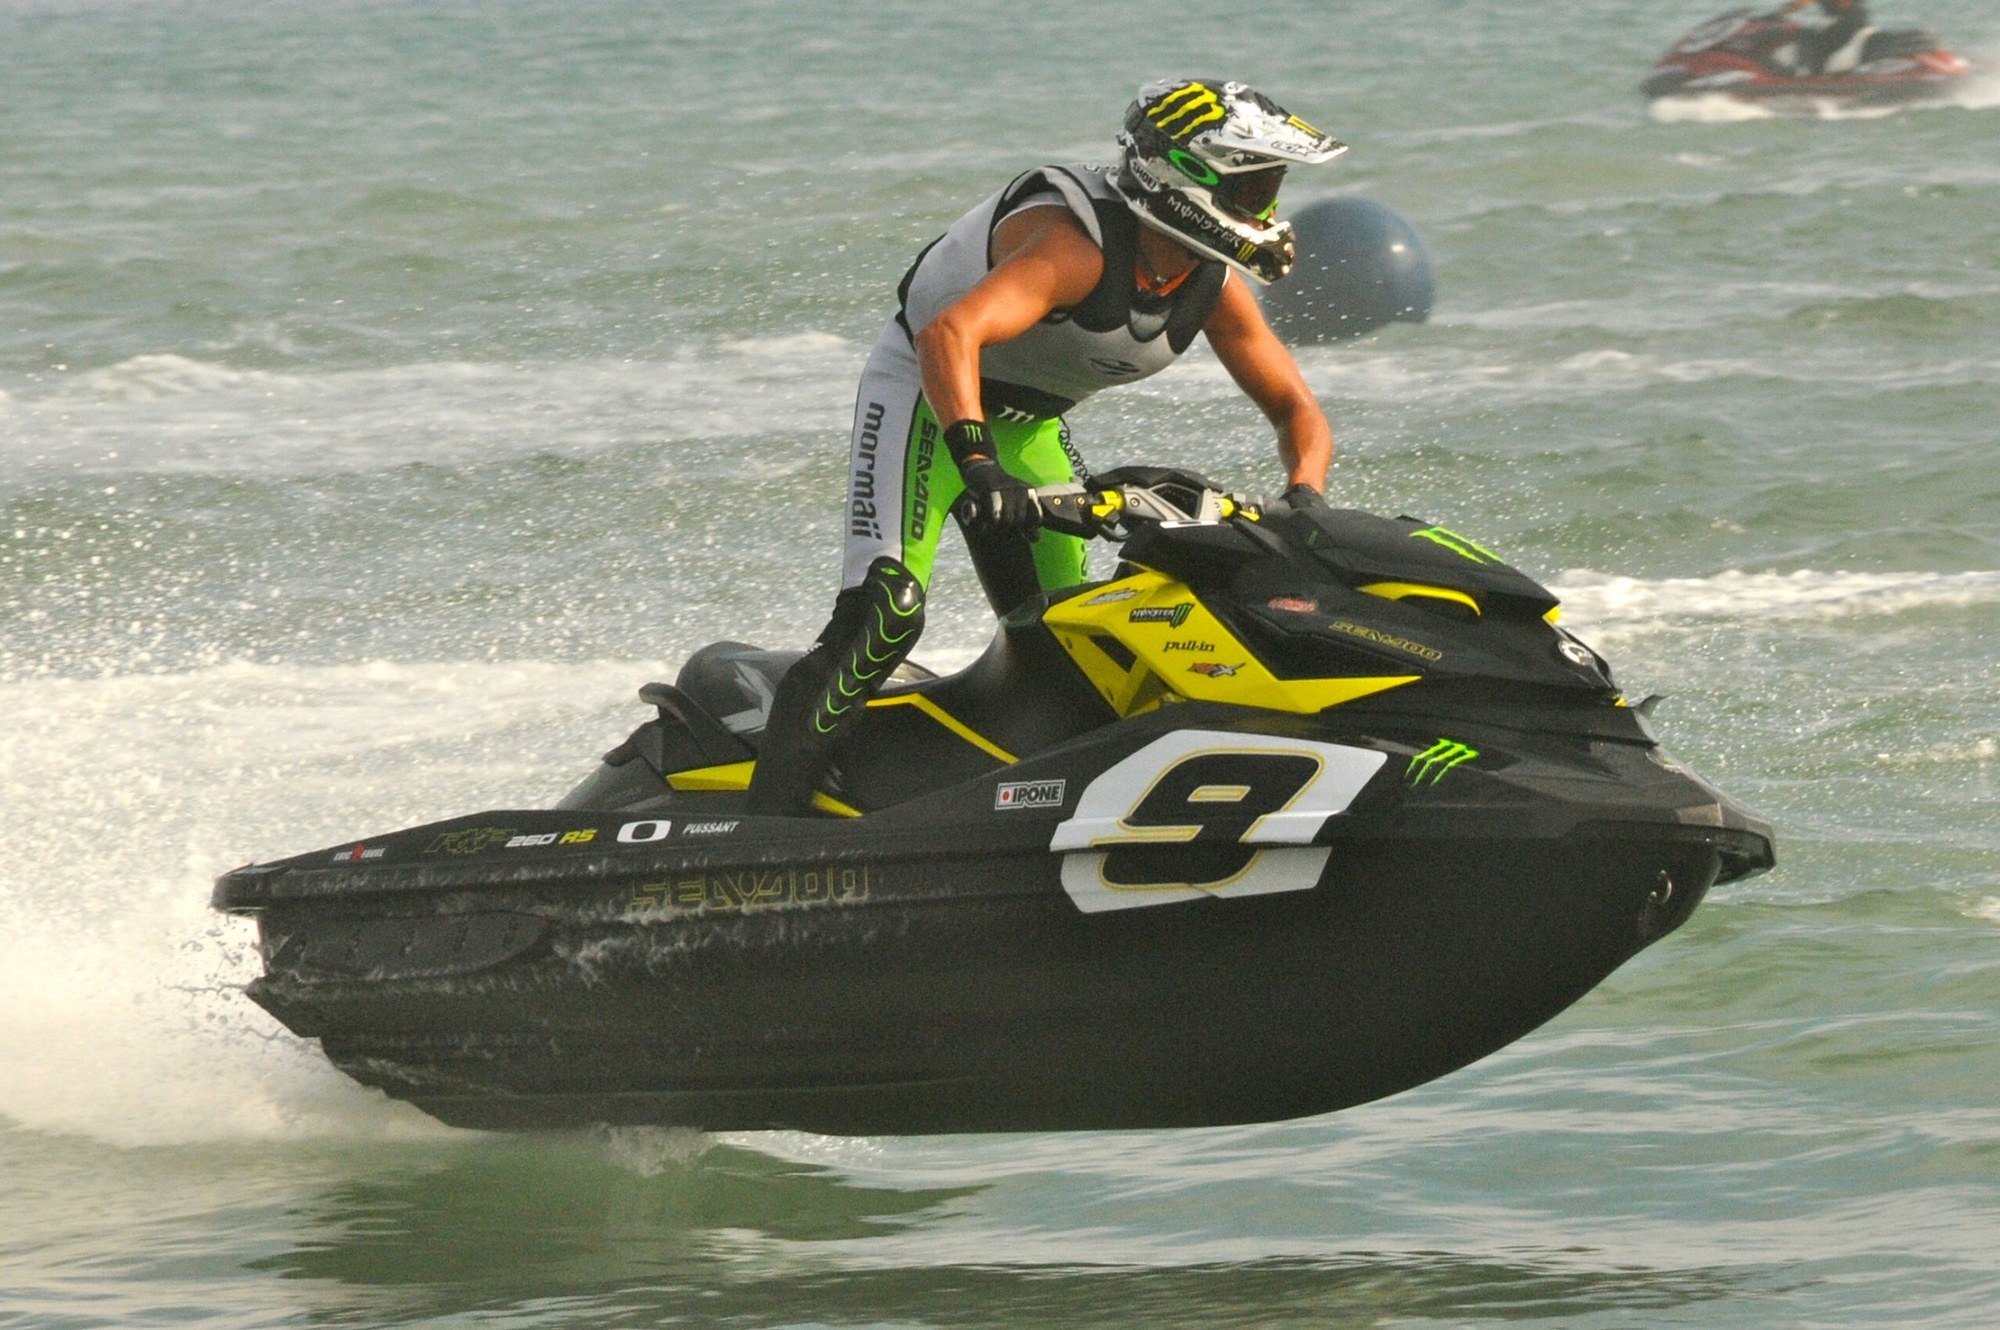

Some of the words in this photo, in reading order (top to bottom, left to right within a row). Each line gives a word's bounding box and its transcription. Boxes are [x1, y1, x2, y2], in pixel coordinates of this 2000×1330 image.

[1131, 159, 1157, 190] SHOEI
[1167, 196, 1242, 248] MONSTER
[851, 402, 886, 541] mormaii
[1162, 639, 1216, 652] pull-in
[1011, 782, 1061, 804] IPONE
[505, 832, 558, 847] 260
[558, 829, 598, 845] RS
[682, 821, 740, 834] PUISSANT
